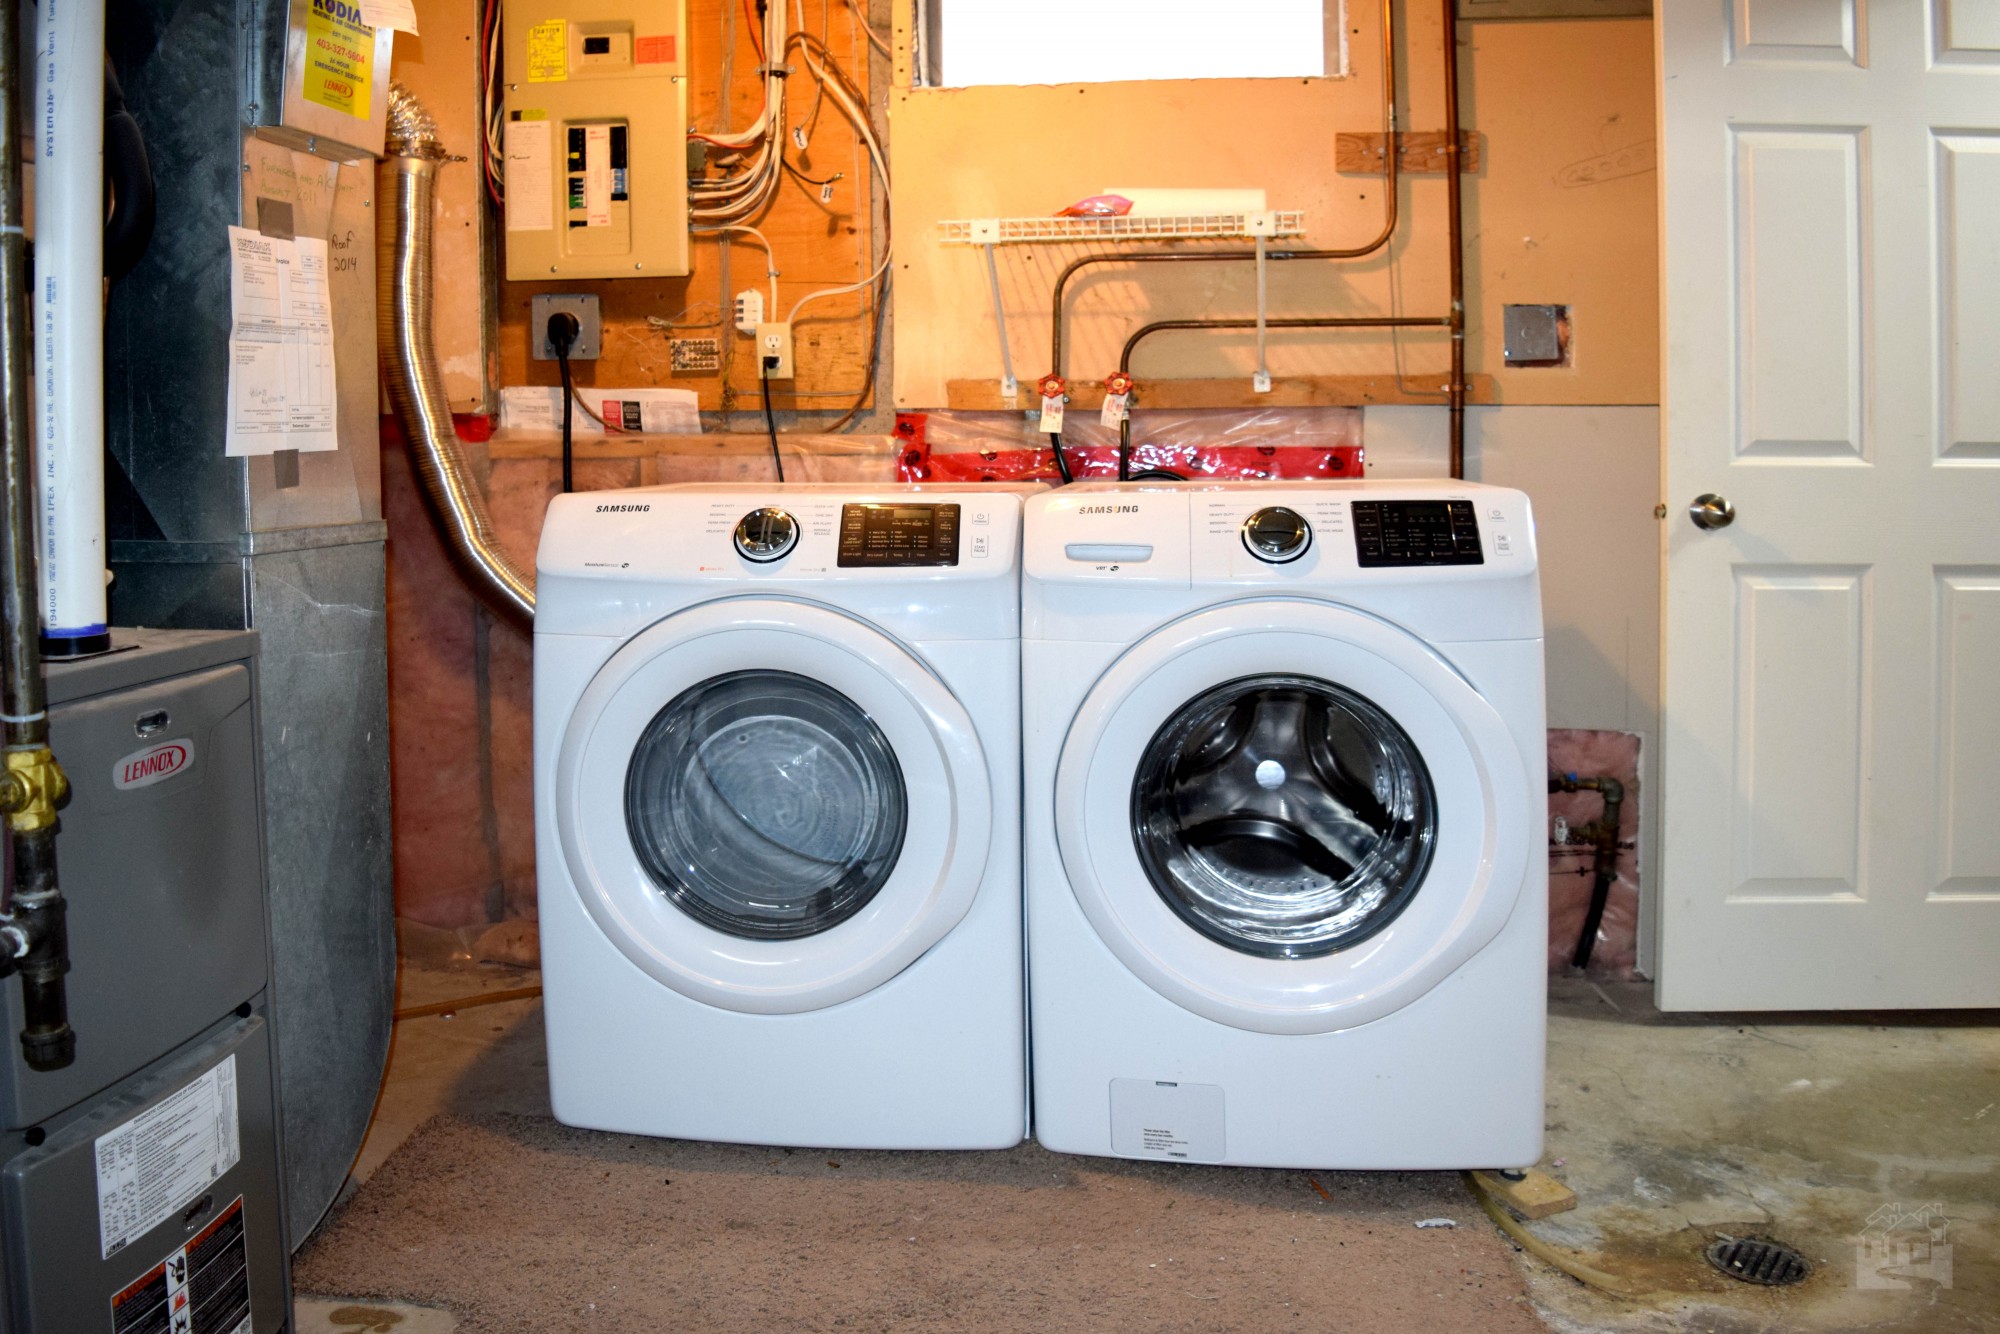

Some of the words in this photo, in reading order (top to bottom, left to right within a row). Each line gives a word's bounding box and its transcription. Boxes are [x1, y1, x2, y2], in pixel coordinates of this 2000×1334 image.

[312, 8, 331, 21] HEATING
[344, 20, 373, 38] CONDITIONING
[46, 30, 55, 56] Vent
[46, 63, 55, 83] Gas
[314, 60, 344, 76] EMERGENCY
[344, 70, 364, 83] SERVICE
[323, 80, 349, 95] LENNOX
[45, 116, 54, 158] SYSTEM
[333, 257, 357, 272] 2014
[595, 504, 651, 513] SAMSUNG
[1079, 505, 1139, 515] SAMSUNG
[124, 749, 175, 784] LENNOX
